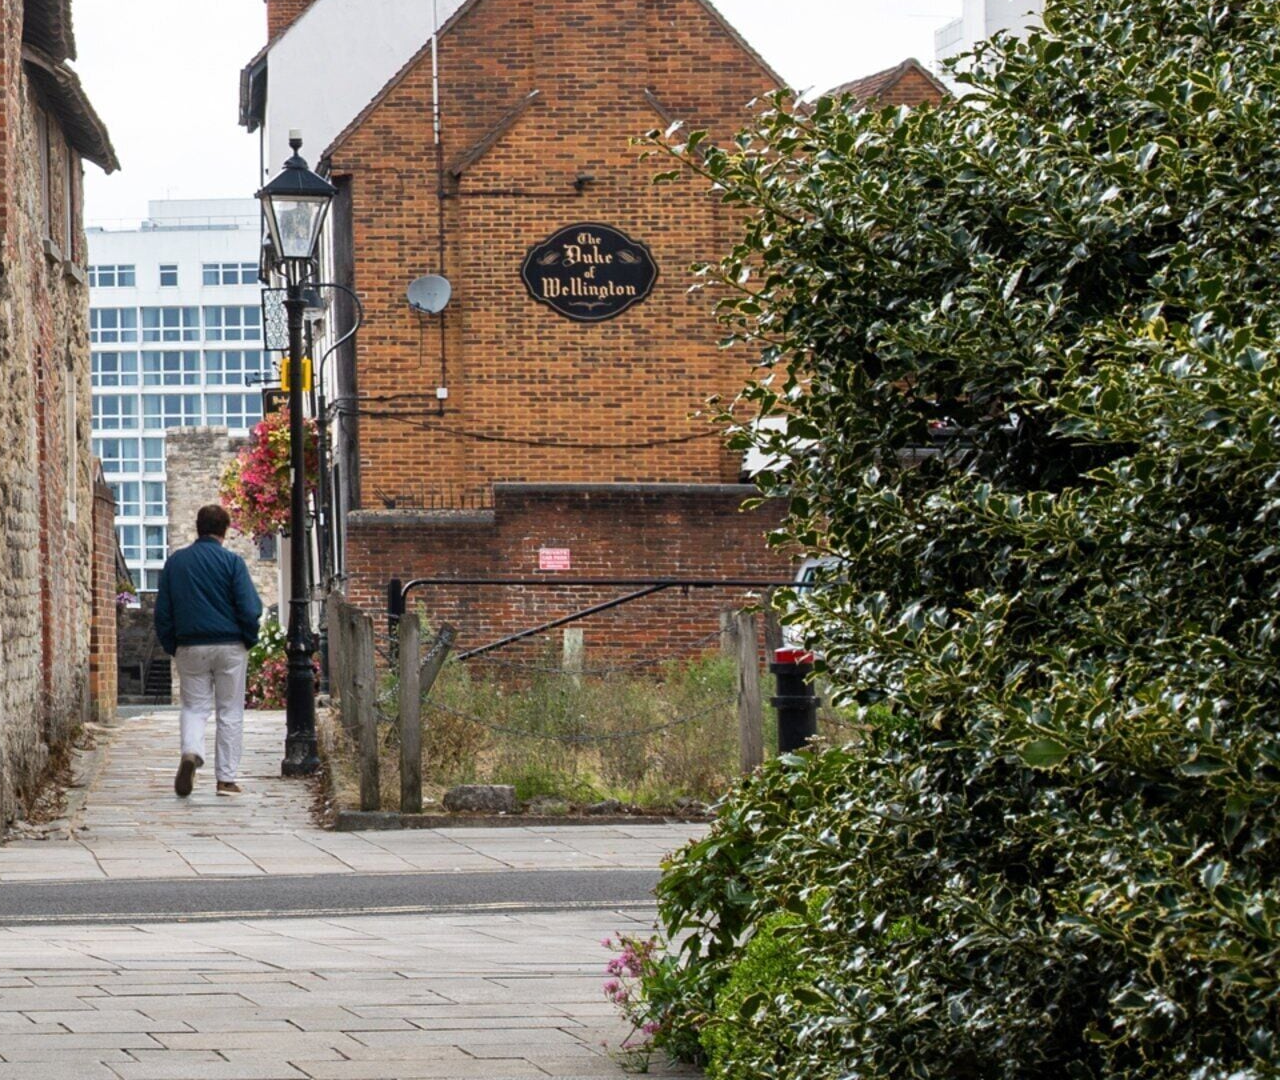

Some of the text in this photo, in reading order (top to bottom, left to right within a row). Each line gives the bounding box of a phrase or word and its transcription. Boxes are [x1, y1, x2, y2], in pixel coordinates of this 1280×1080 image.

[577, 232, 602, 245] The
[562, 244, 613, 267] Duke
[583, 266, 596, 279] of
[541, 277, 637, 300] Wellington
